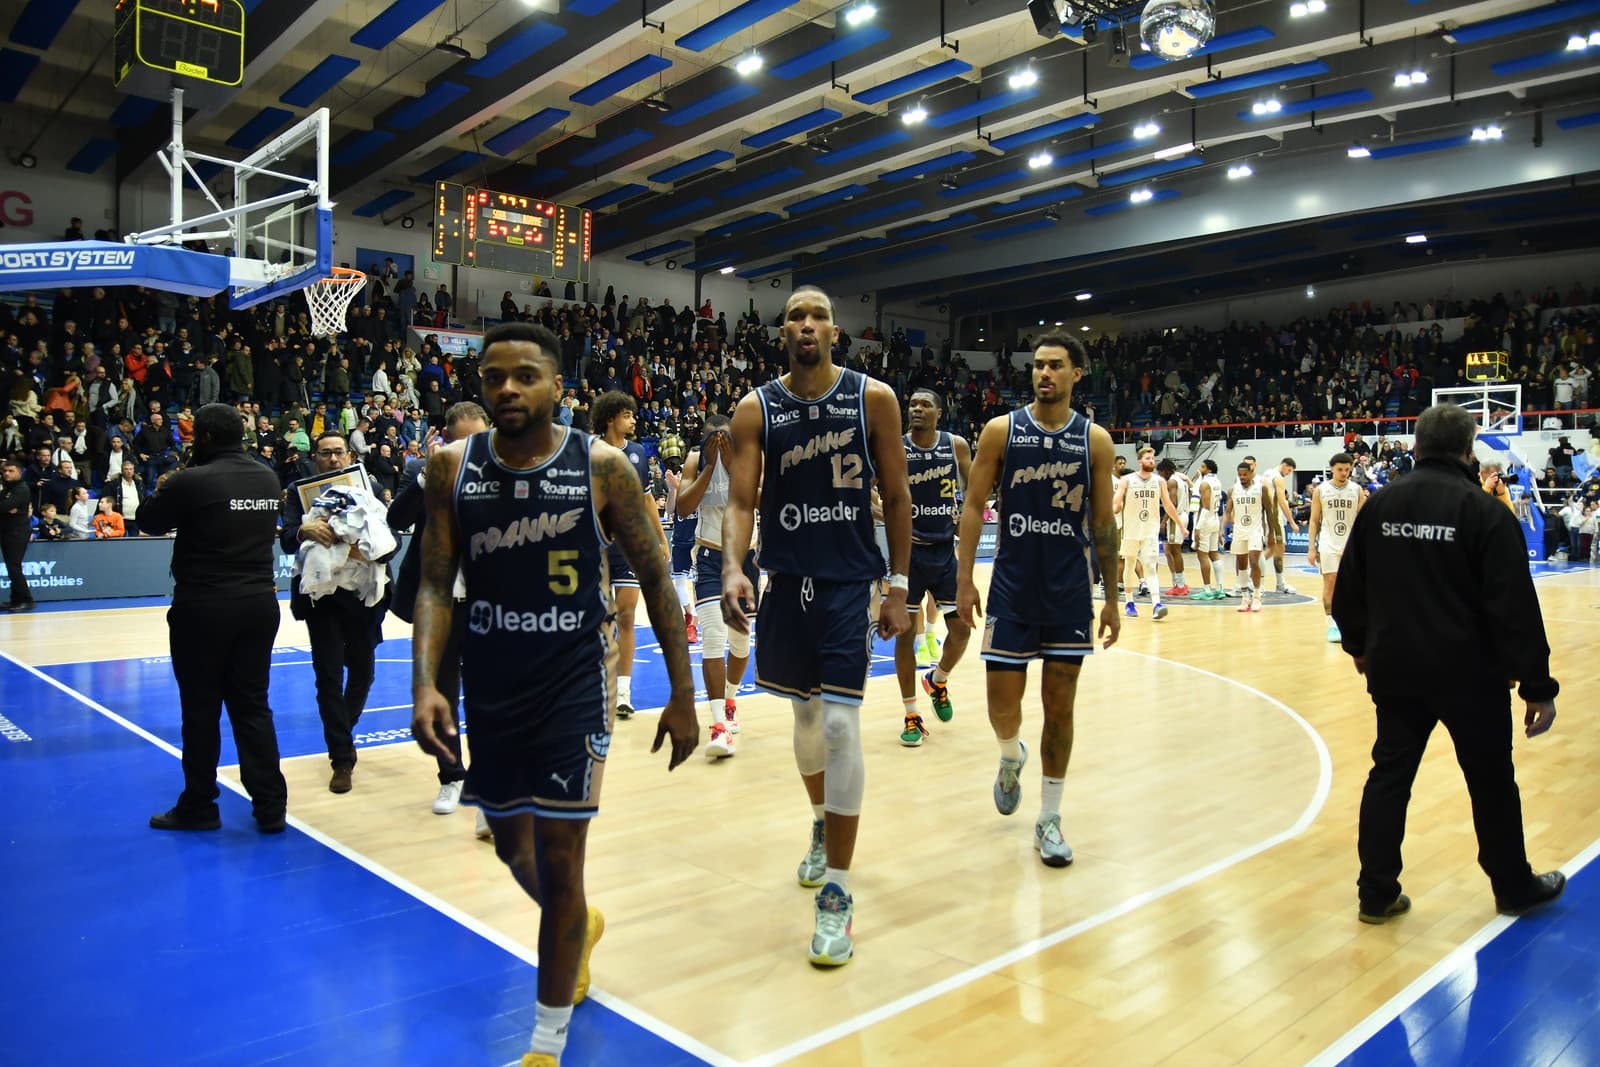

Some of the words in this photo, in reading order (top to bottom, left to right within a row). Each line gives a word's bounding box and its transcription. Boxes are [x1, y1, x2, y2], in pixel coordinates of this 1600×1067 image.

[178, 63, 206, 76] Bodet
[771, 409, 801, 425] Loire
[780, 426, 858, 477] ROANNE
[1011, 434, 1040, 445] Loire
[831, 453, 864, 489] 12
[1010, 460, 1083, 489] ROANNE
[539, 479, 588, 496] Roanne
[1050, 479, 1085, 513] 24
[229, 498, 280, 511] SECURITE
[803, 499, 861, 524] leader
[471, 507, 585, 561] ROANNE
[1381, 521, 1457, 543] SECURITE
[547, 549, 580, 596] 5
